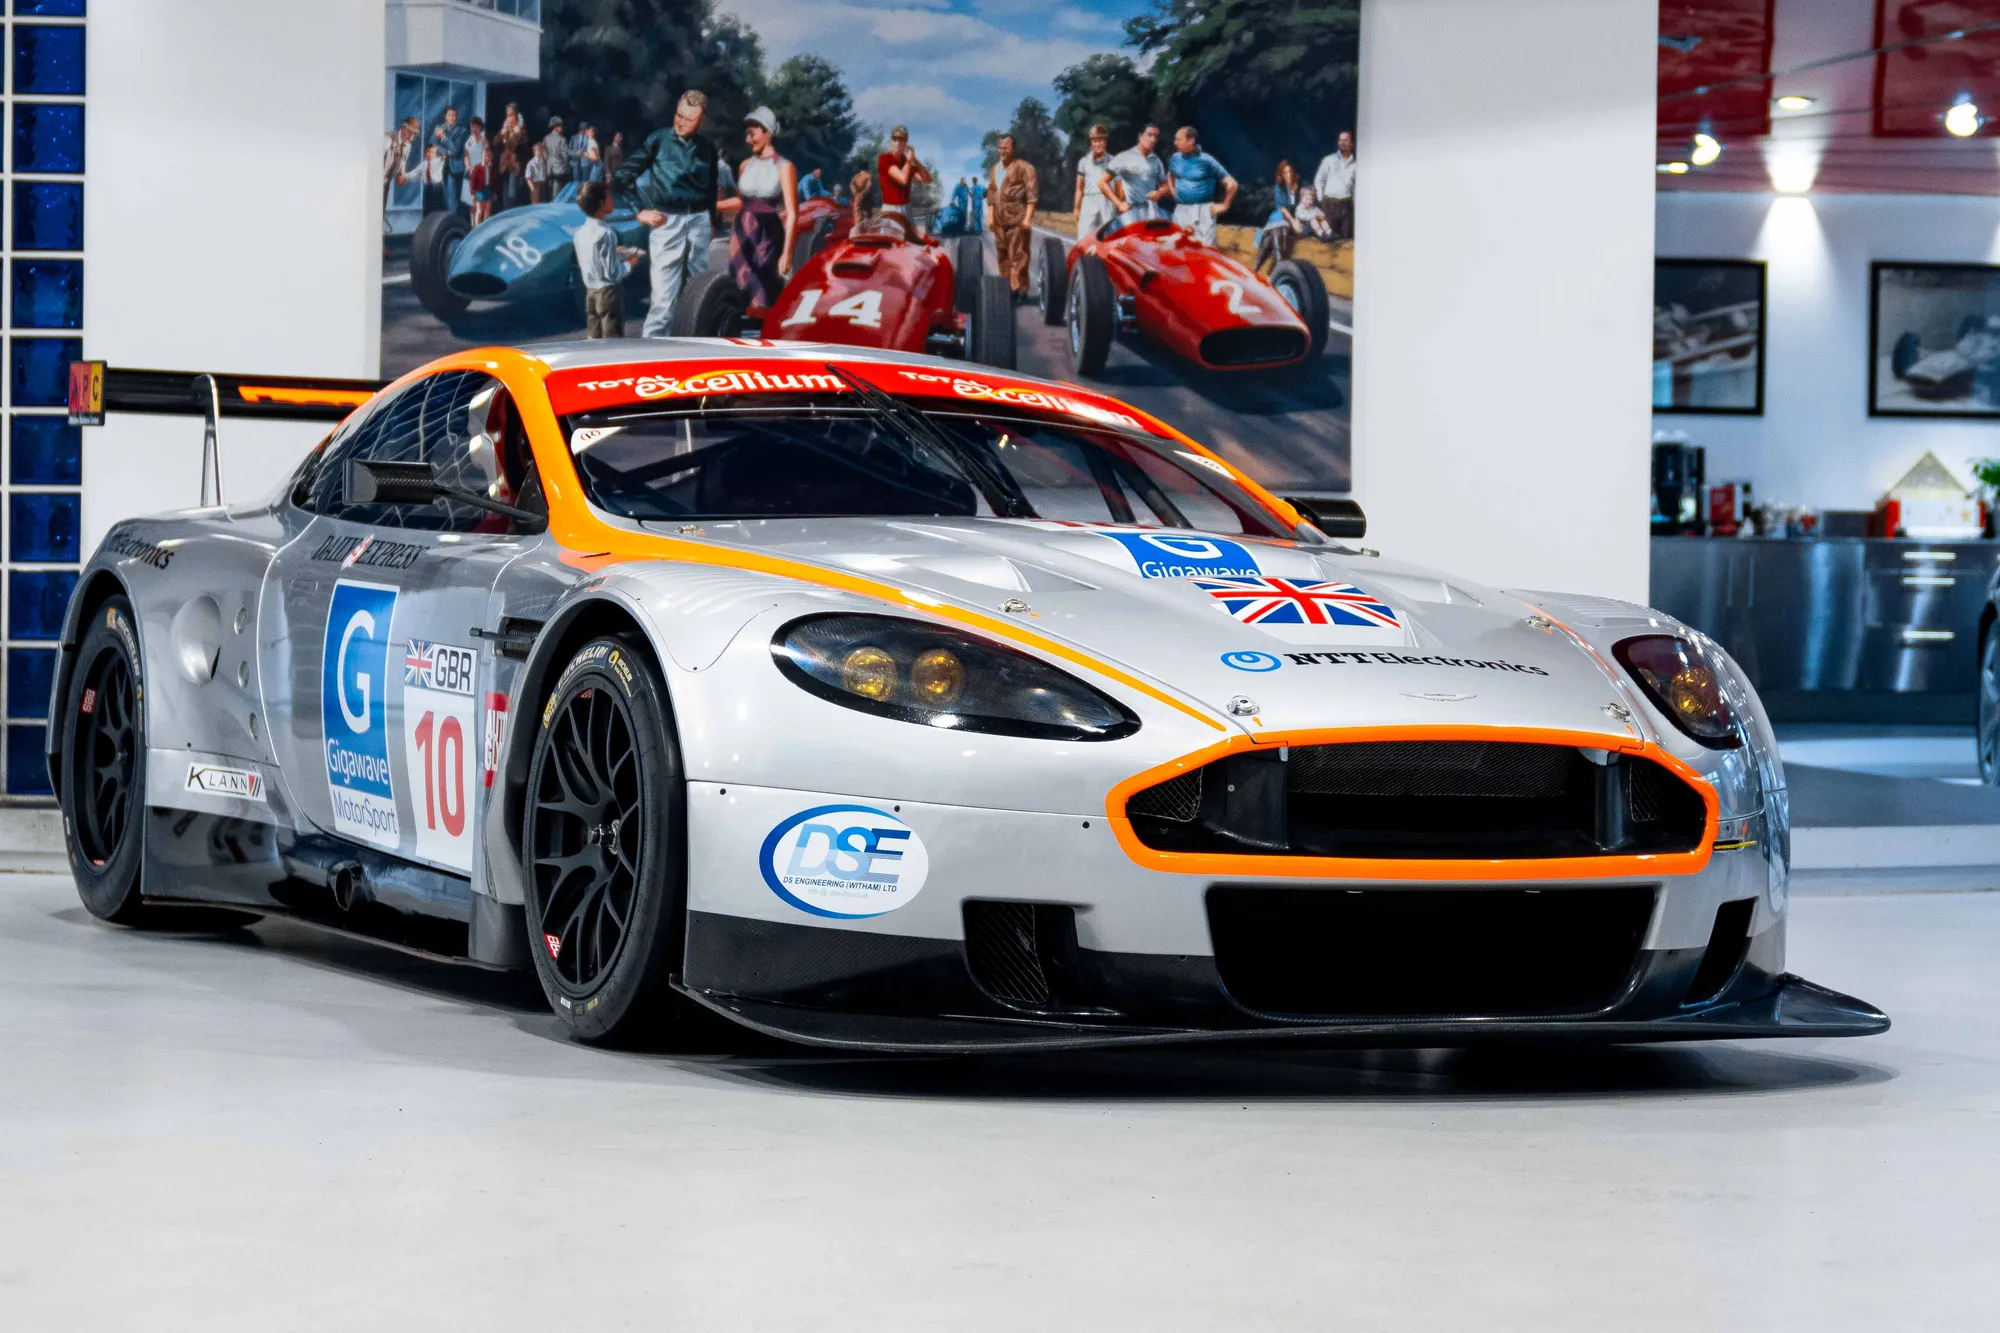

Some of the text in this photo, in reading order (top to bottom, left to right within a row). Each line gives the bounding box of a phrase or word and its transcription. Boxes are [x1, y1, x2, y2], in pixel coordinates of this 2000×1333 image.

[494, 236, 542, 270] 18
[781, 289, 883, 328] 14
[1210, 279, 1263, 314] 2
[578, 371, 847, 398] TOTAL excellium
[898, 371, 1144, 429] TOTAL excellim
[356, 540, 430, 570] EXPRESS
[337, 609, 375, 734] G
[435, 649, 472, 692] GBR
[1283, 652, 1550, 677] NTT Electronics
[187, 766, 248, 790] KLANN
[327, 738, 389, 785] Gigawave
[415, 710, 465, 837] 10
[333, 791, 397, 835] MotorSport
[785, 823, 911, 885] DSE
[783, 876, 897, 893] DS ENGINEERING (WITHAM) LTD
